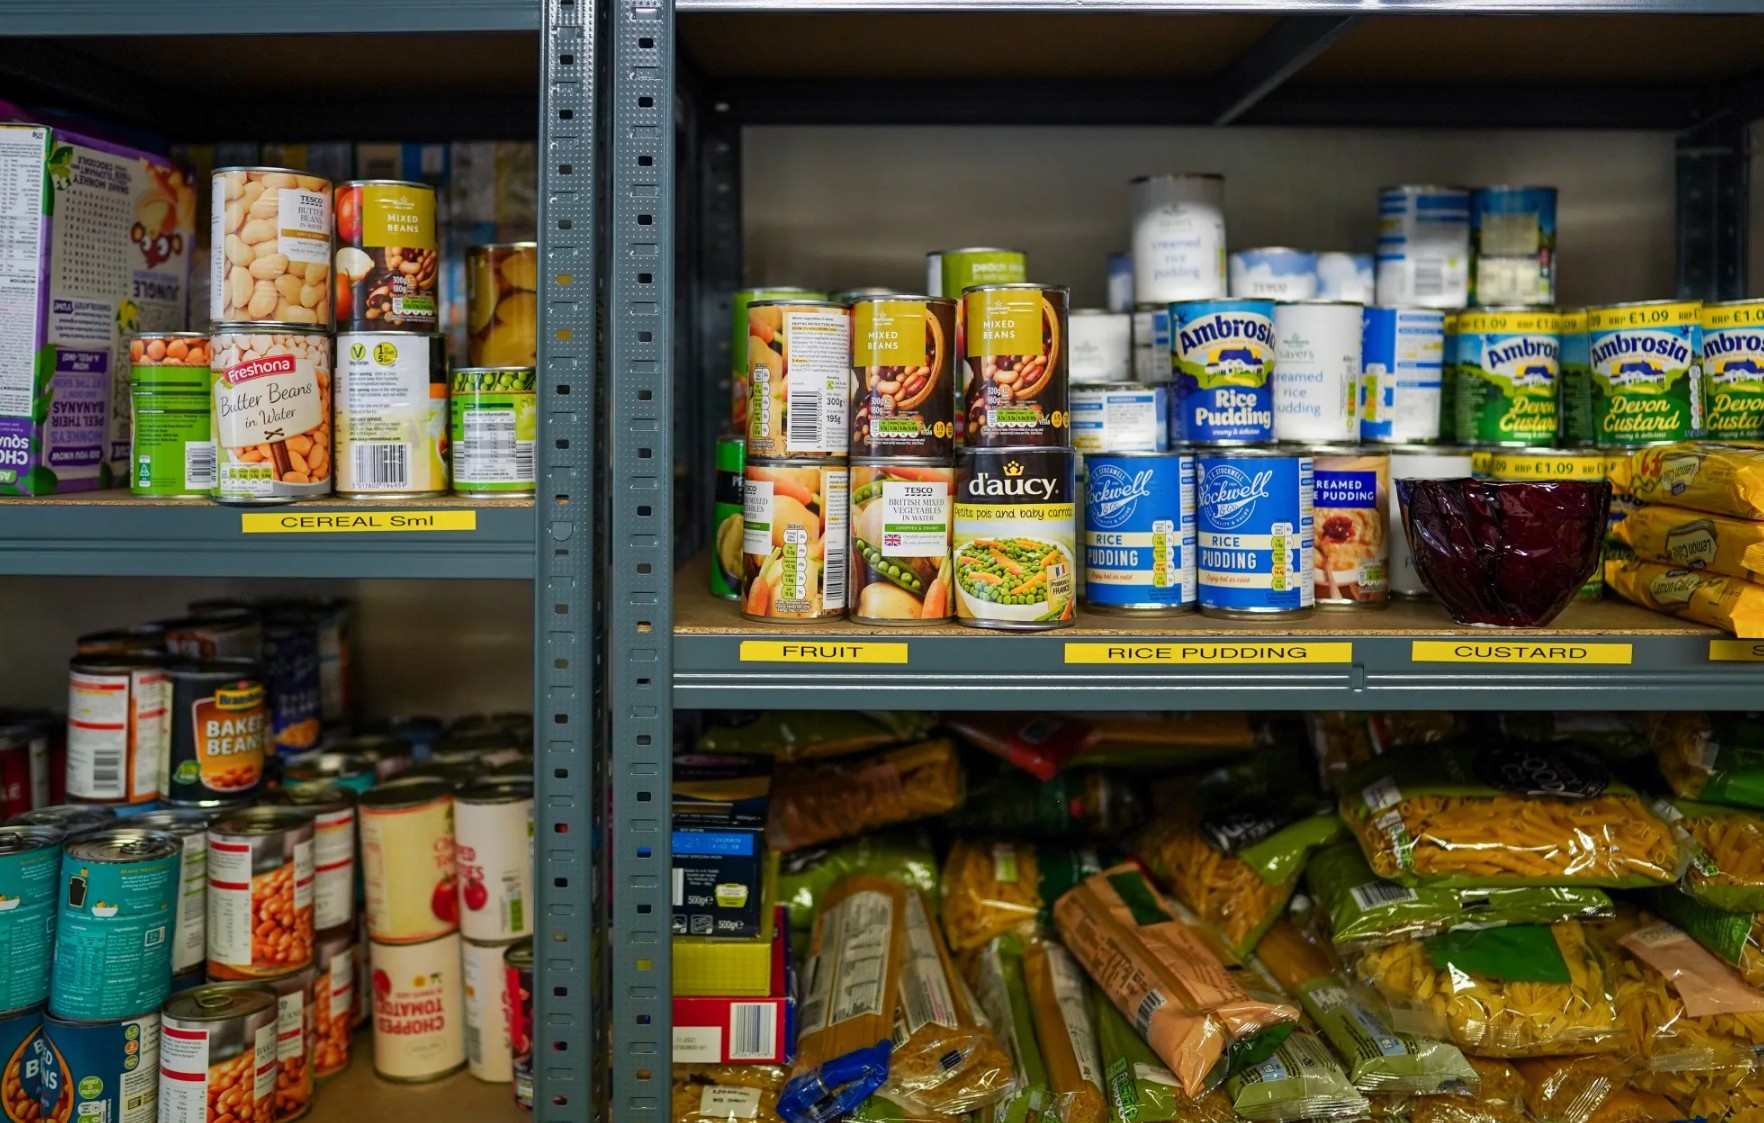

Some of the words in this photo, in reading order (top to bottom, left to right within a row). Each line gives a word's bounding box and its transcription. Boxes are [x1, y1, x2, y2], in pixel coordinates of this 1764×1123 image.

[301, 195, 323, 204] TESCO
[388, 214, 419, 223] MIXED
[388, 225, 419, 233] BEANS
[133, 279, 179, 299] JUNGLE
[983, 320, 1015, 328] MIXED
[1609, 316, 1625, 325] RRP
[1629, 311, 1668, 324] £1.09
[1712, 315, 1729, 324] RRP
[868, 331, 898, 339] MIXED
[983, 330, 1015, 339] BEANS
[1180, 315, 1275, 356] Ambrosia
[867, 341, 898, 350] BEANS
[1592, 333, 1689, 369] Ambrosia
[1279, 350, 1314, 359] savers
[228, 359, 291, 382] Freshona
[1275, 370, 1324, 382] reamed
[1216, 389, 1258, 408] Rice
[1283, 387, 1307, 398] rice
[221, 393, 262, 417] Butter
[267, 382, 312, 404] Beans
[826, 397, 843, 408] 300g
[1610, 395, 1670, 414] Devon
[52, 400, 105, 413] BANANAS
[1277, 402, 1321, 417] udding
[52, 415, 81, 427] THEIR
[83, 415, 104, 427] PEEL
[246, 418, 257, 429] in
[258, 408, 297, 426] Water
[826, 415, 841, 425] 195g
[1195, 407, 1271, 429] Pudding
[1603, 410, 1681, 433] Custard
[51, 450, 75, 461] KNOW
[75, 450, 89, 460] YOU
[1098, 467, 1126, 480] STOCKWELL
[1215, 467, 1244, 480] STOCKWELL
[1514, 465, 1532, 473] RRP
[1534, 462, 1574, 474] £1.09
[1675, 462, 1696, 477] Lemon
[969, 472, 1057, 500] d'aucy
[1316, 480, 1362, 490] REAMED
[1323, 491, 1374, 501] PUDDING
[889, 498, 921, 507] BRITISH
[922, 498, 945, 506] MIXED
[893, 506, 942, 515] VEGETABLES
[976, 509, 992, 521] pois
[996, 509, 1016, 519] and
[1020, 508, 1045, 521] baby
[1048, 508, 1072, 518] carrots
[281, 516, 383, 529] CEREAL
[390, 515, 433, 528] Sml
[1096, 534, 1122, 545] RICE
[1212, 536, 1240, 547] RICE
[1689, 539, 1711, 554] Lemon
[1088, 549, 1139, 567] PUDDING
[1203, 551, 1257, 569] PUDDING
[1052, 585, 1070, 595] FRANCE
[1654, 580, 1673, 596] Lemon
[783, 645, 863, 658] FRUIT
[1107, 647, 1172, 659] RICE
[1182, 647, 1307, 659] PUDDING
[1454, 645, 1587, 659] CUSTARD
[1752, 645, 1764, 657] S
[206, 736, 262, 756] BEAN
[688, 895, 705, 906] 500g
